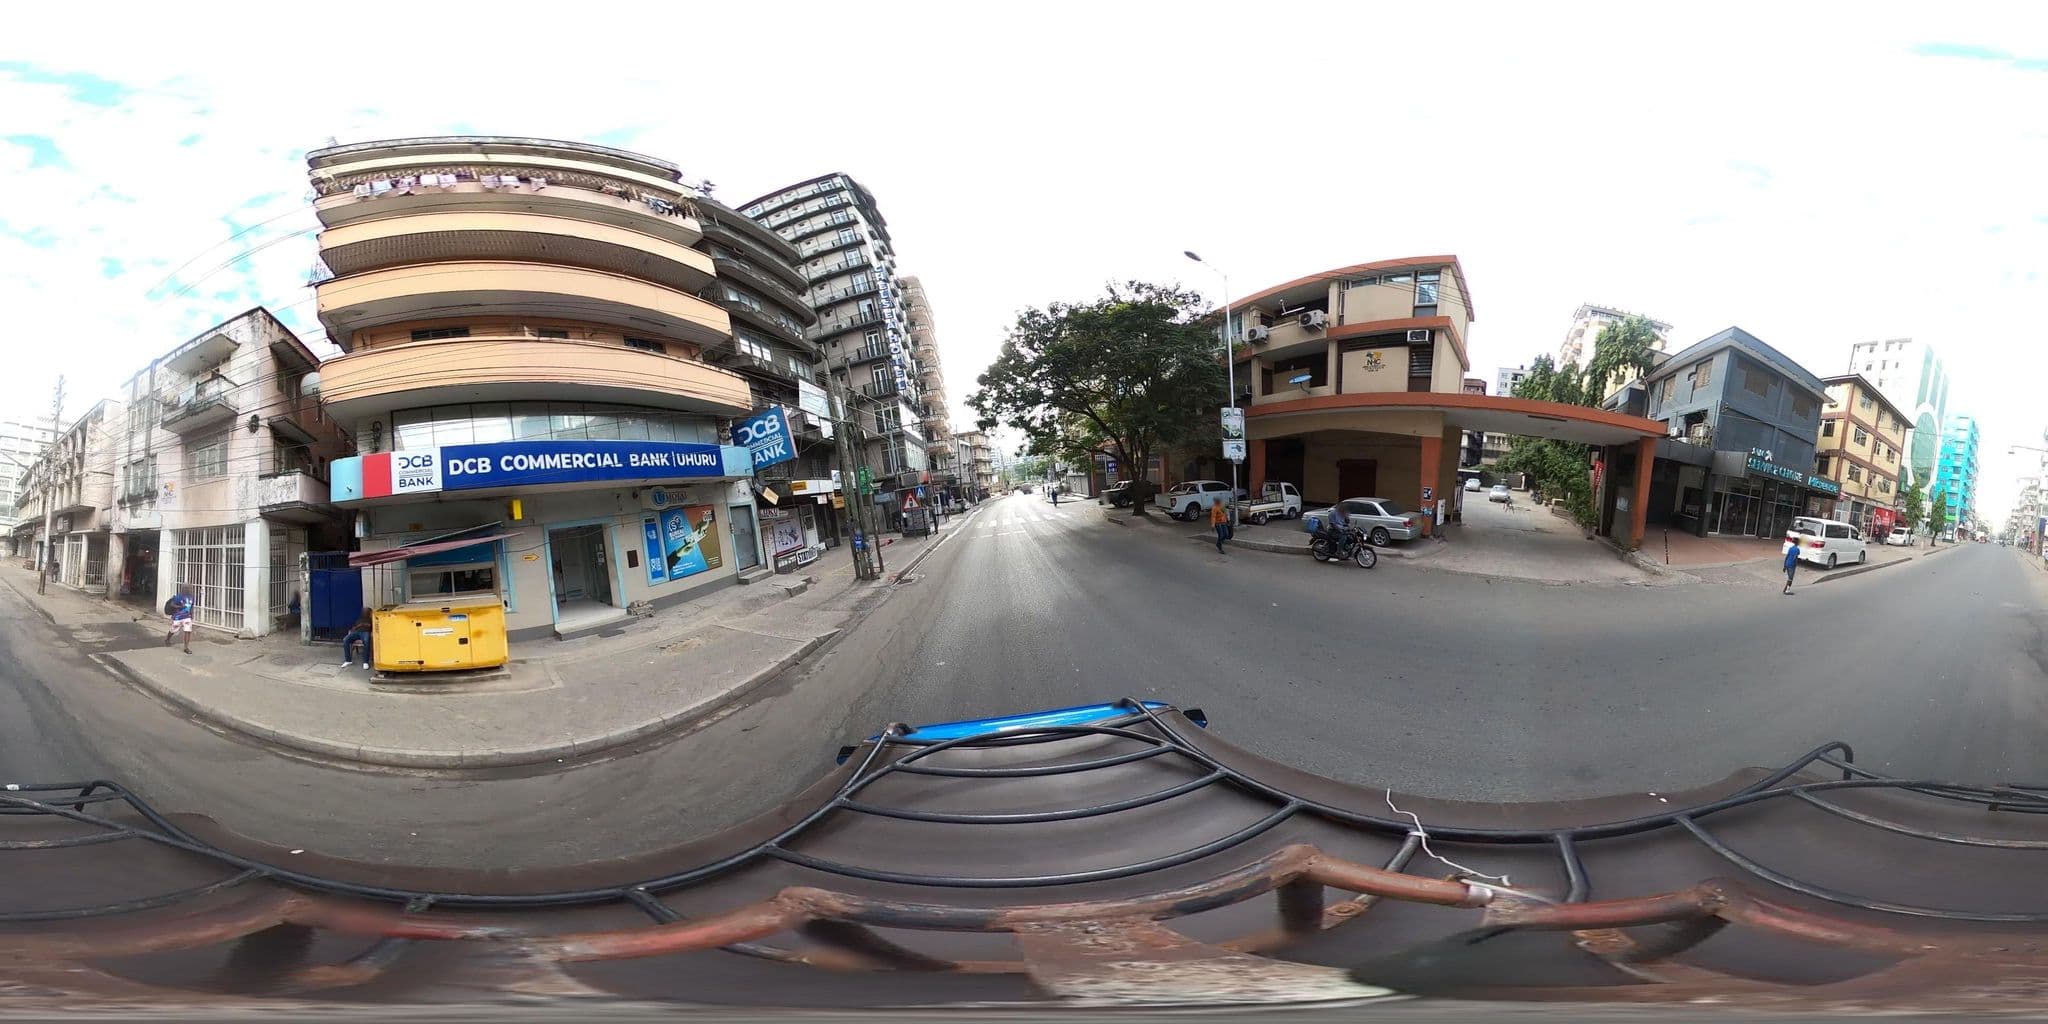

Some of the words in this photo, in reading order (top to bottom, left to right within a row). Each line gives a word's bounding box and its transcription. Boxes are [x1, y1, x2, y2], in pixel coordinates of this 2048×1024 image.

[737, 414, 781, 445] DCB
[398, 454, 433, 469] DCB
[448, 456, 492, 476] DCB
[500, 453, 623, 472] COMMERCIAL
[629, 452, 670, 467] BANK
[677, 452, 717, 467] UHURU
[755, 441, 787, 465] ANK
[399, 476, 434, 488] BANK
